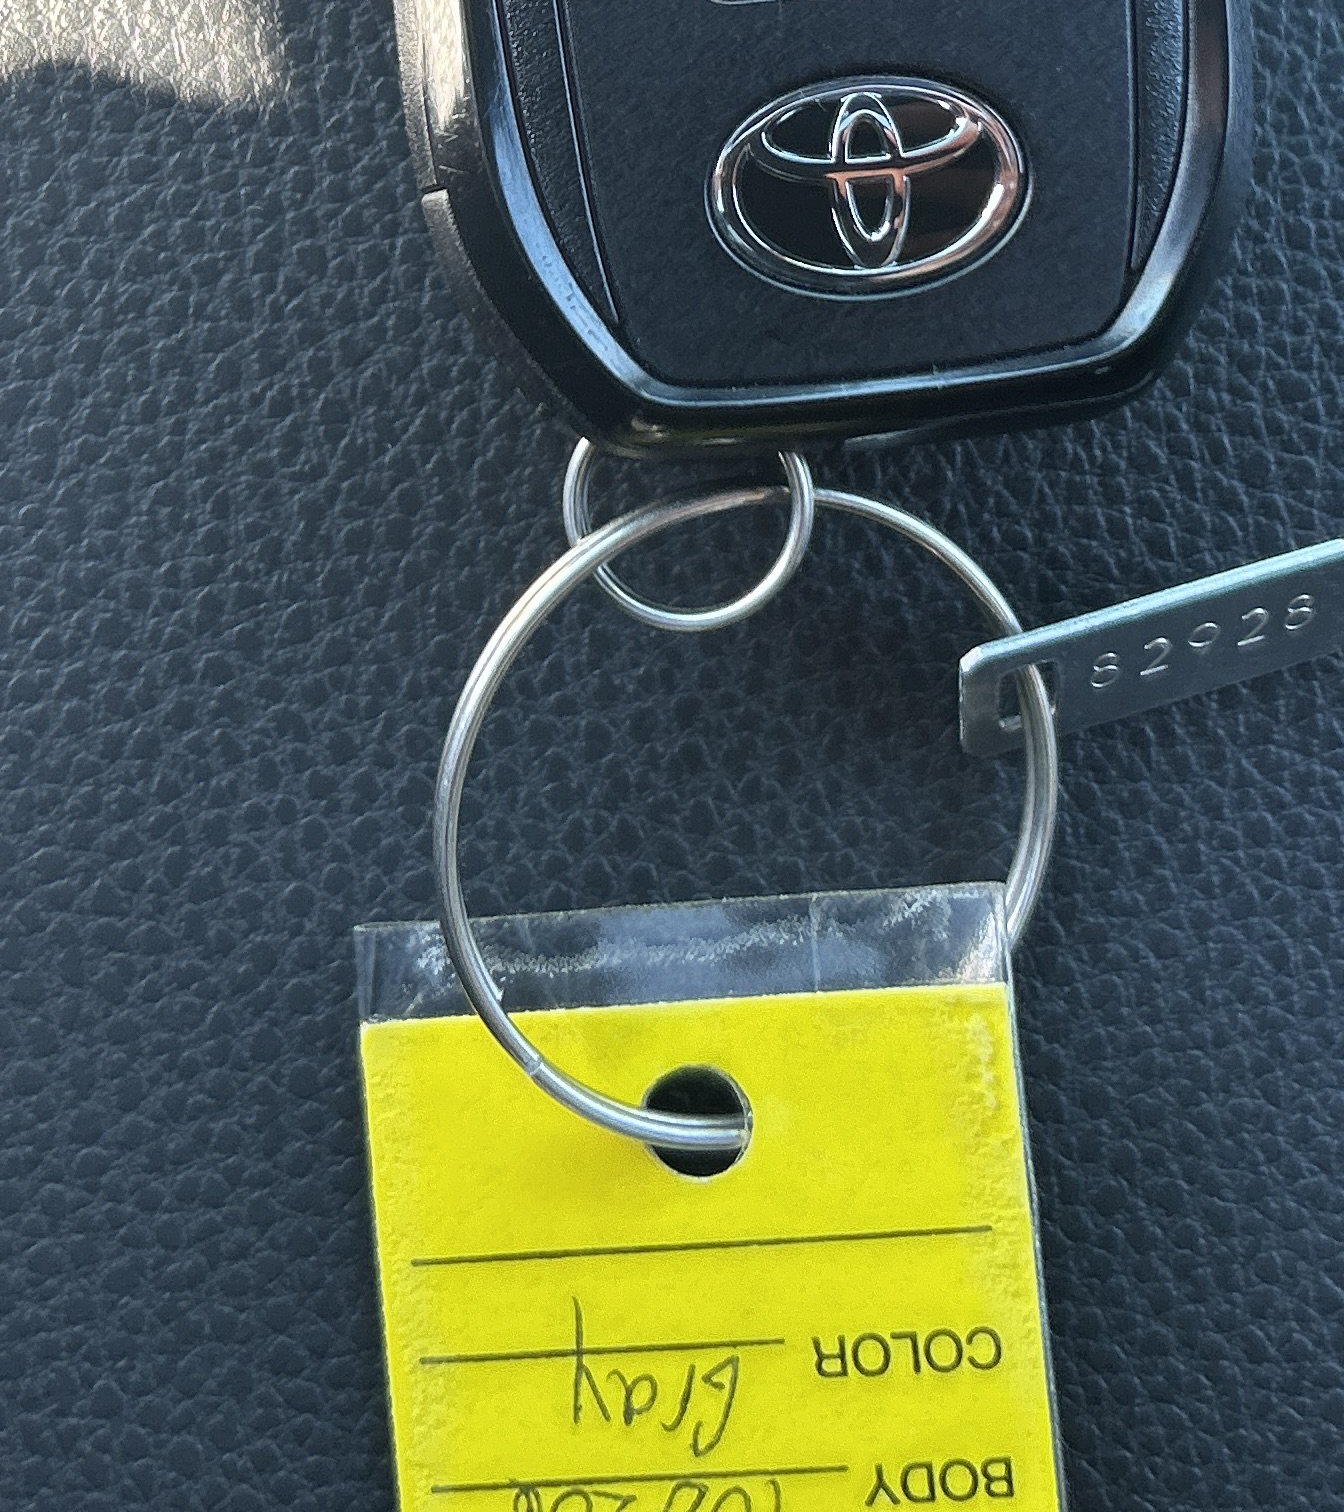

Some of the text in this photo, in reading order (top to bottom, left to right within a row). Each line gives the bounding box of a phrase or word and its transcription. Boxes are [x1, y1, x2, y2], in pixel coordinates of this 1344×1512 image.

[571, 1295, 740, 1456] Gray
[814, 1326, 1002, 1378] COLOR
[865, 1456, 1015, 1507] BODY
